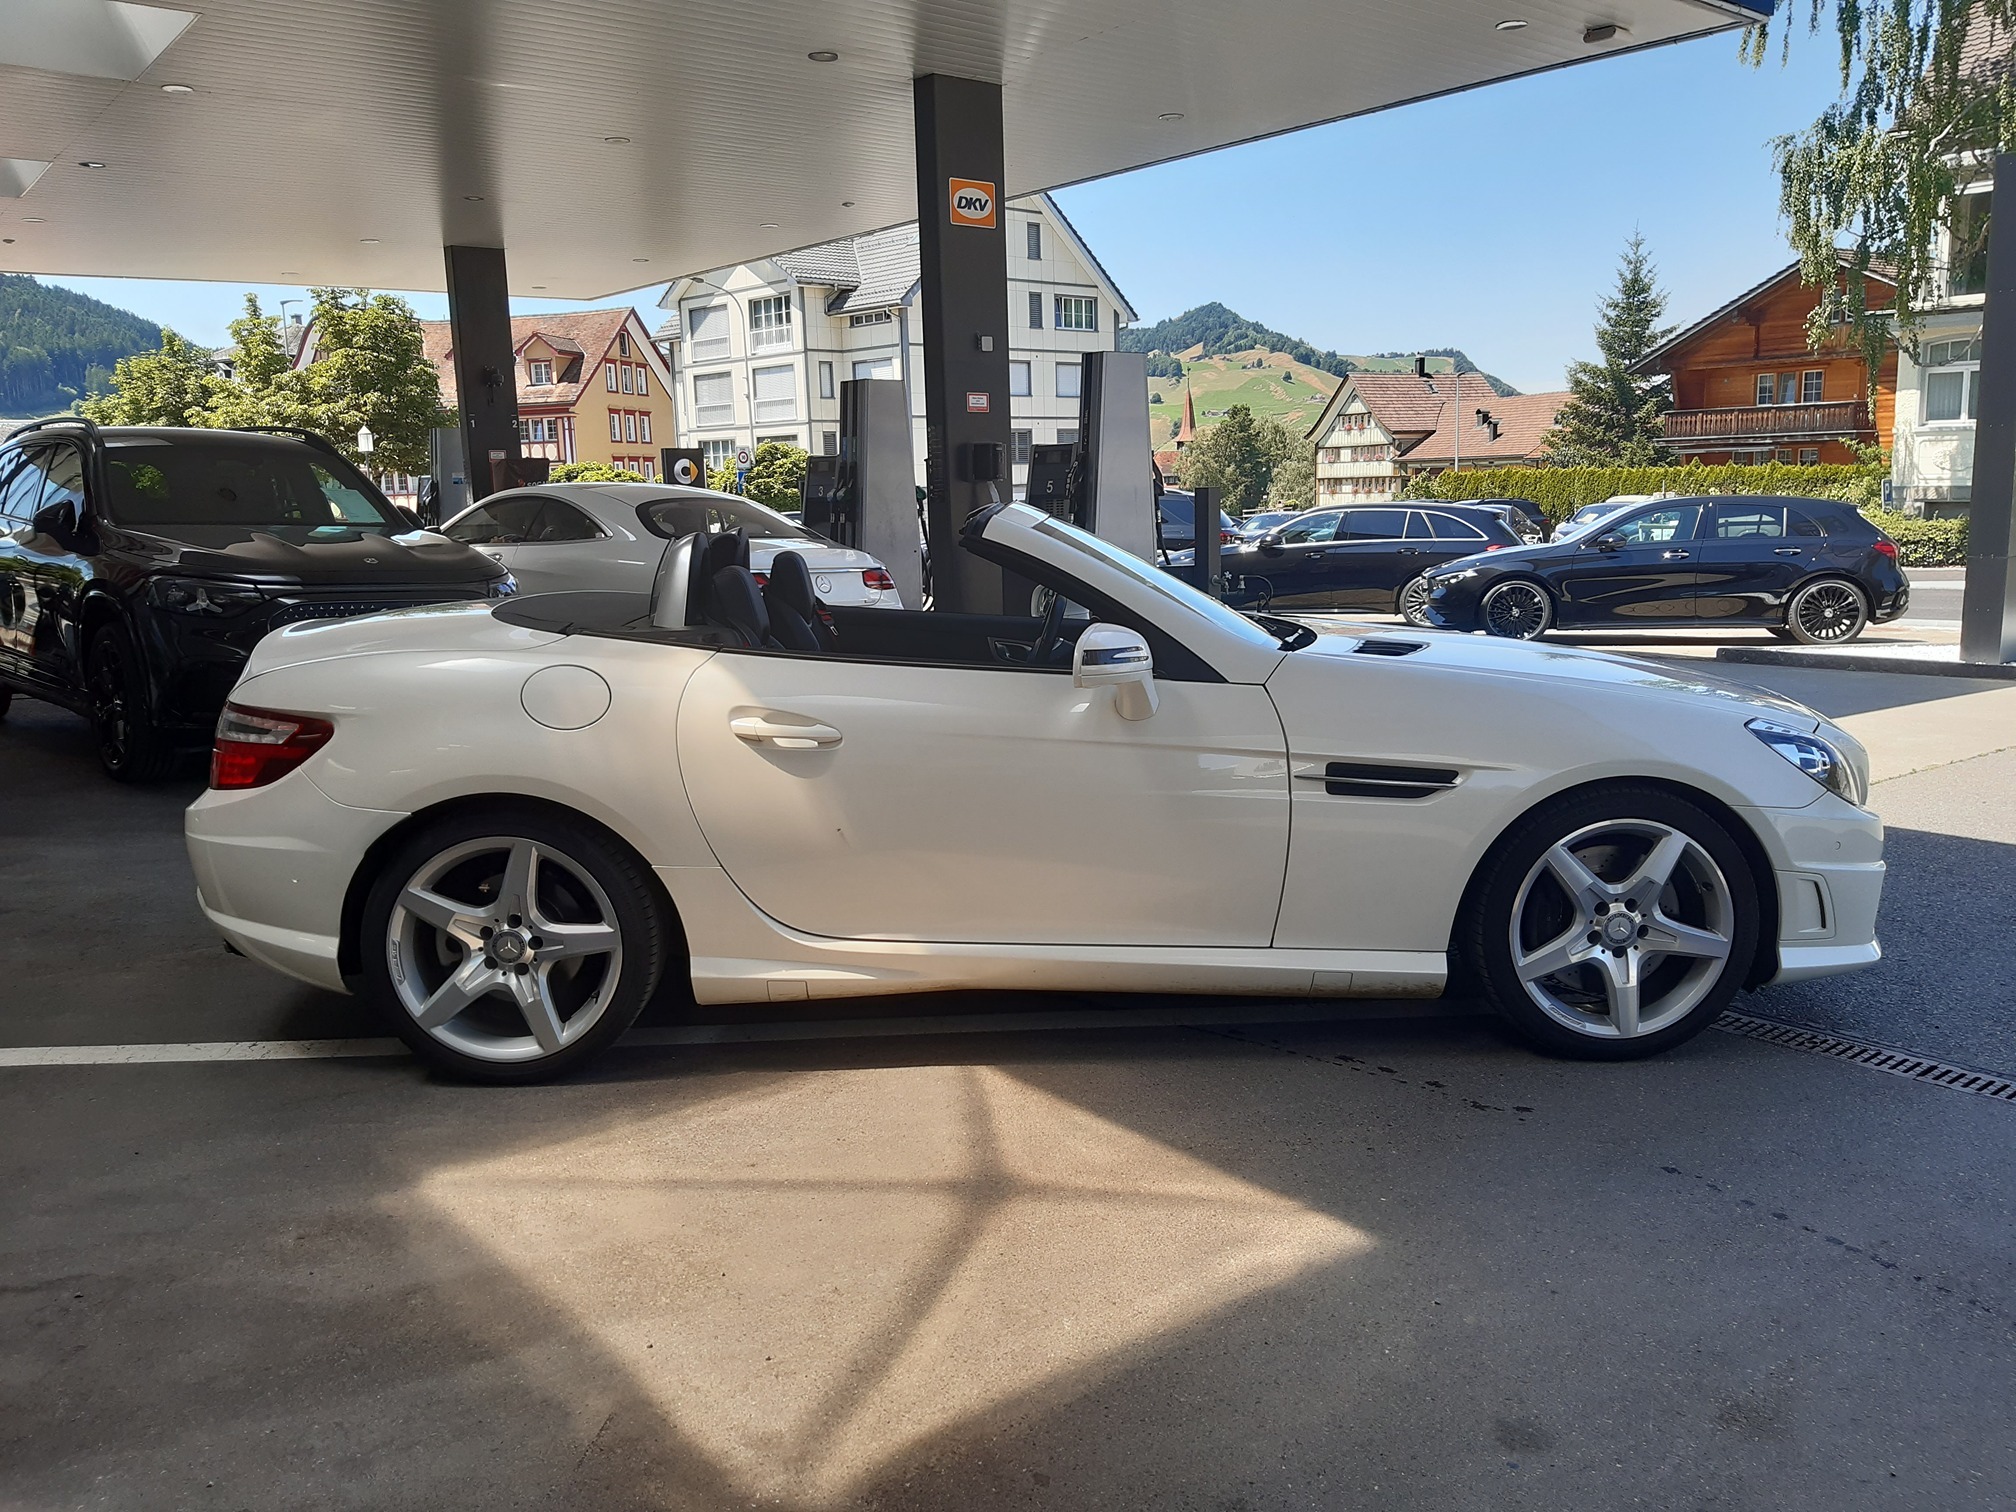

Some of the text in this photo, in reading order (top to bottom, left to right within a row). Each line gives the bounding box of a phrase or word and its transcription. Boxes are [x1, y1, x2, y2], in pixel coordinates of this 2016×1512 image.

[956, 195, 990, 212] DKV
[470, 419, 476, 428] 1
[512, 419, 518, 428] 2
[818, 486, 824, 497] 3
[1046, 480, 1053, 493] 5
[1884, 483, 1890, 500] P
